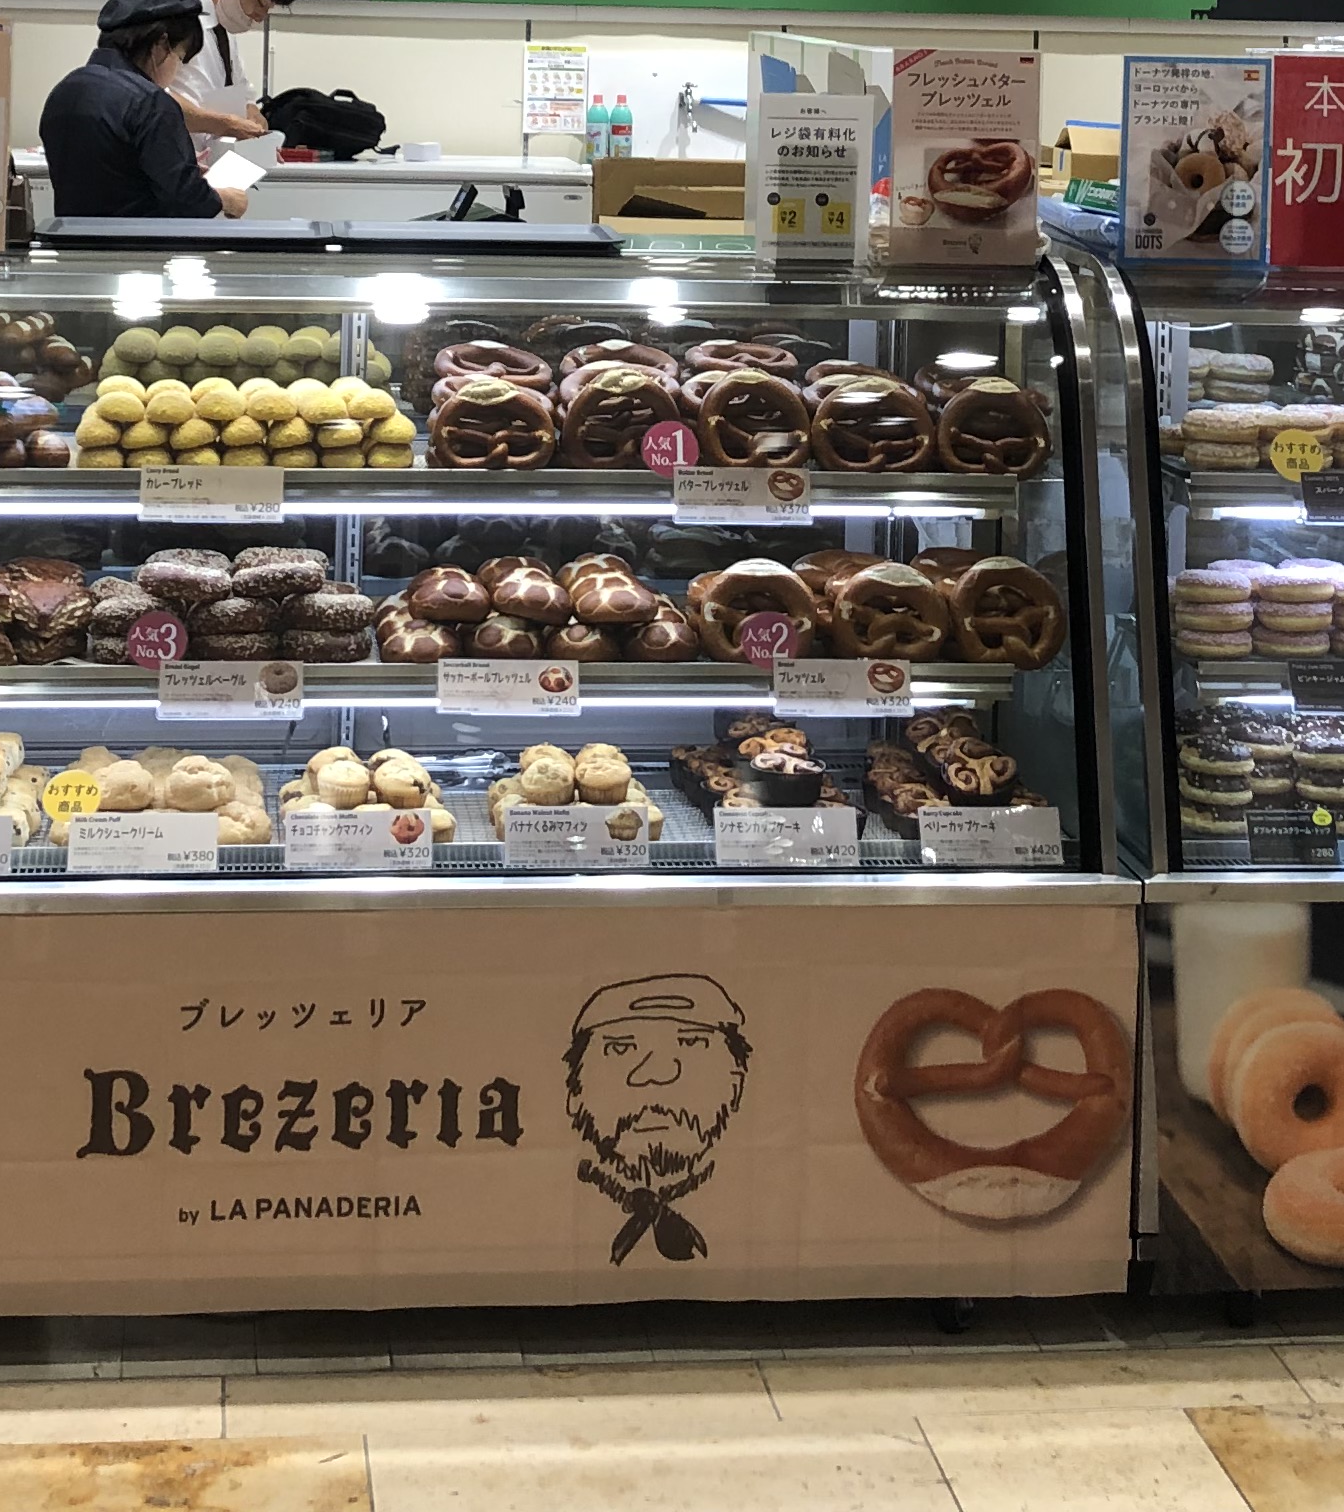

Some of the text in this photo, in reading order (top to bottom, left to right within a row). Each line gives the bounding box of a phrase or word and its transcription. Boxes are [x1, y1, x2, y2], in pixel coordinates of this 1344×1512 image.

[908, 73, 1026, 89] フレッシュバター
[771, 127, 856, 141] レジ袋有料化
[777, 145, 847, 159] のお知らせ
[1135, 234, 1163, 250] DOTS
[644, 436, 672, 451] 人気
[1274, 442, 1322, 455] おすすめ
[251, 503, 280, 512] ¥280
[781, 504, 808, 514] ¥370
[131, 627, 159, 642] 人気
[745, 628, 772, 642] 人気
[271, 699, 300, 708] ¥240
[548, 696, 576, 706] ¥240
[881, 696, 910, 706] ¥320
[48, 784, 98, 796] おすすめ
[58, 801, 82, 813] 商品
[79, 827, 163, 839] ミルクシュークリーム
[399, 847, 430, 858] ¥320
[616, 845, 647, 856] ¥320
[826, 845, 856, 856] ¥420
[1031, 844, 1060, 855] ¥420
[183, 851, 214, 862] ¥380
[179, 998, 427, 1031] ブレッツェリア
[76, 1068, 524, 1159] Brezeria
[178, 1195, 422, 1226] by LA PANADERIA
